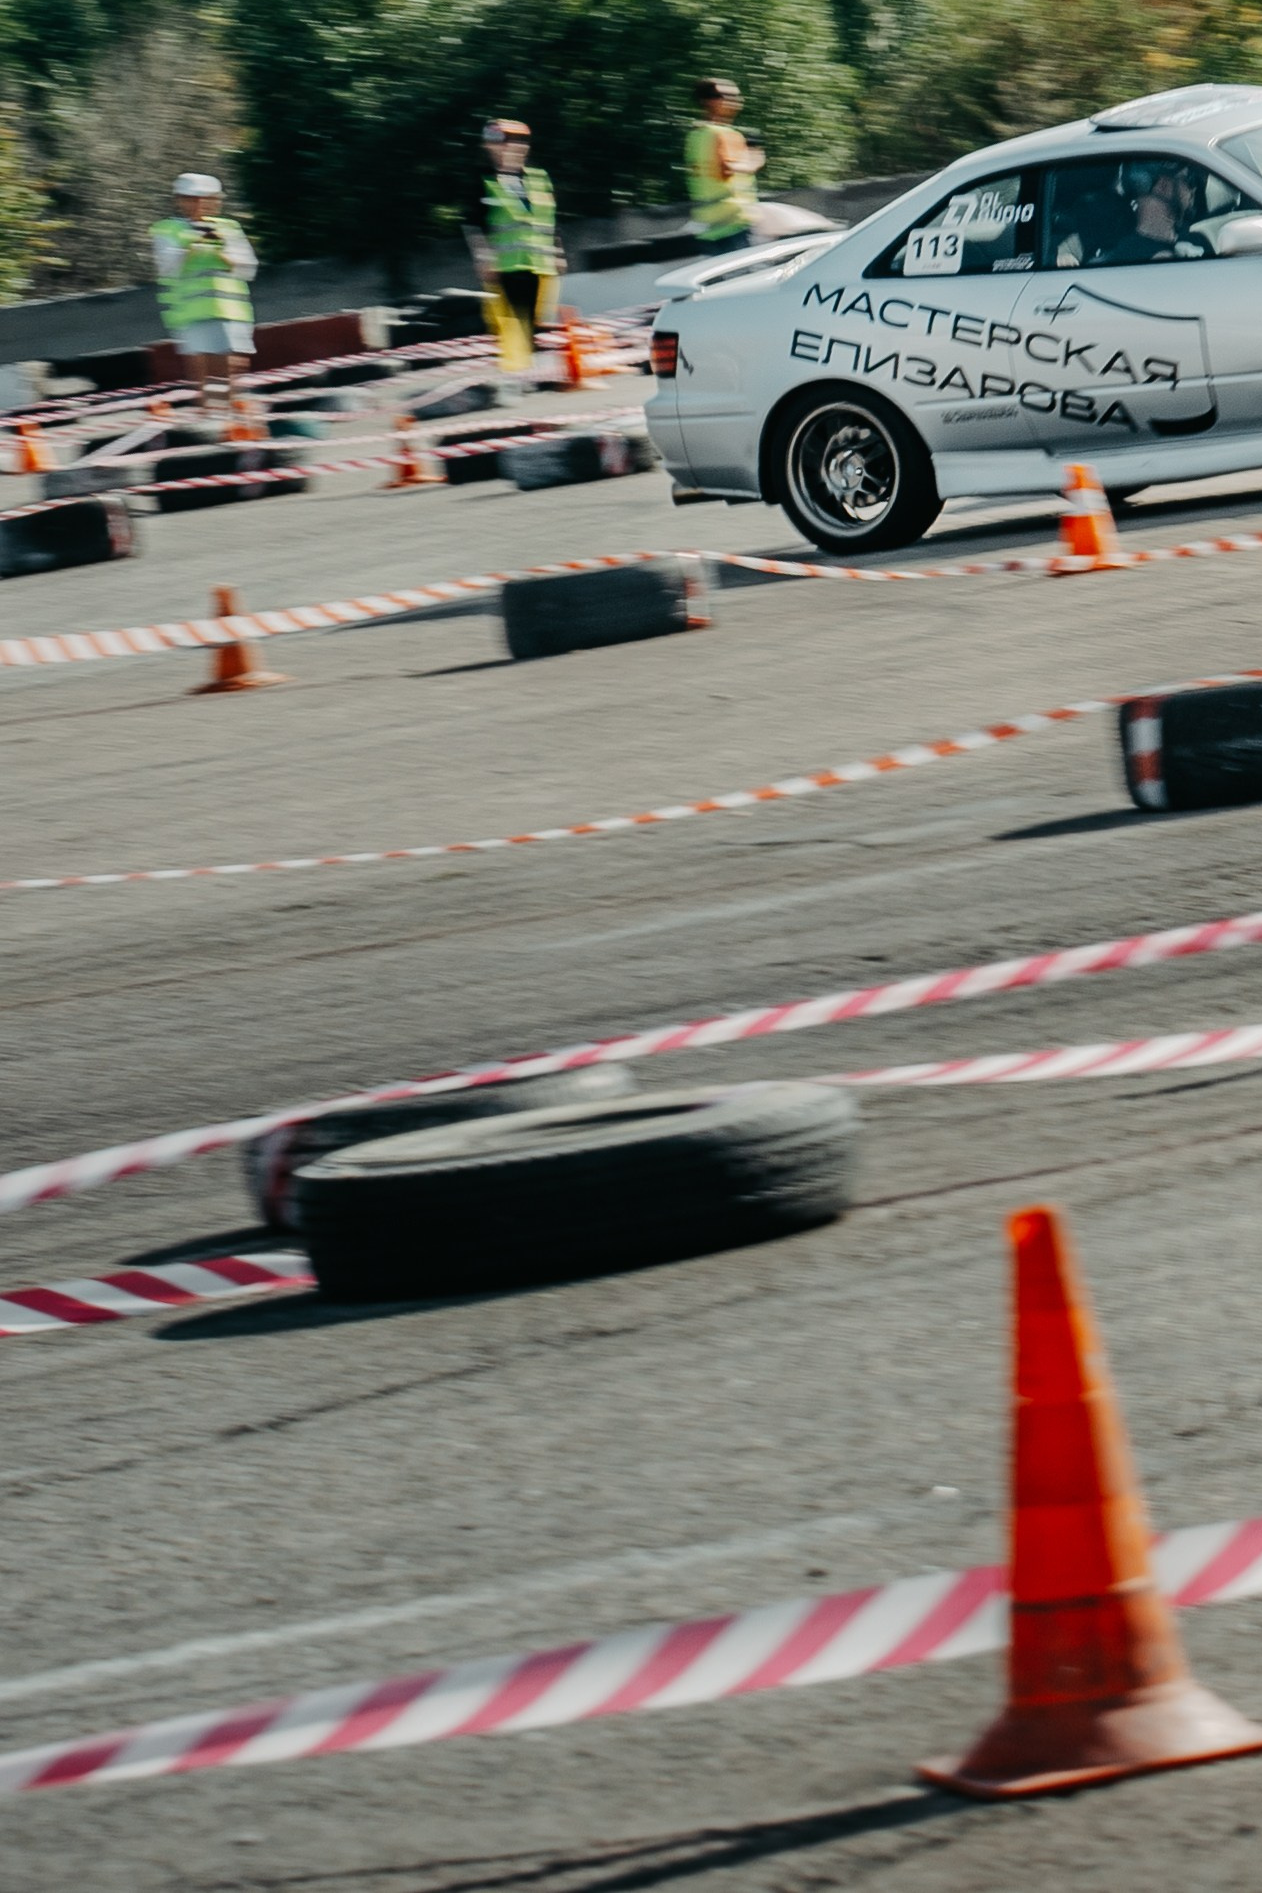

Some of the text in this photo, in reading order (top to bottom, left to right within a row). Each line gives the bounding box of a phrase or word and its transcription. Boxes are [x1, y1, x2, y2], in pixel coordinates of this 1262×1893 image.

[912, 233, 959, 260] 113
[789, 328, 1140, 433] ЕЛИЗАРОВА
[802, 282, 1180, 392] МАСТЕРСКАЯ
